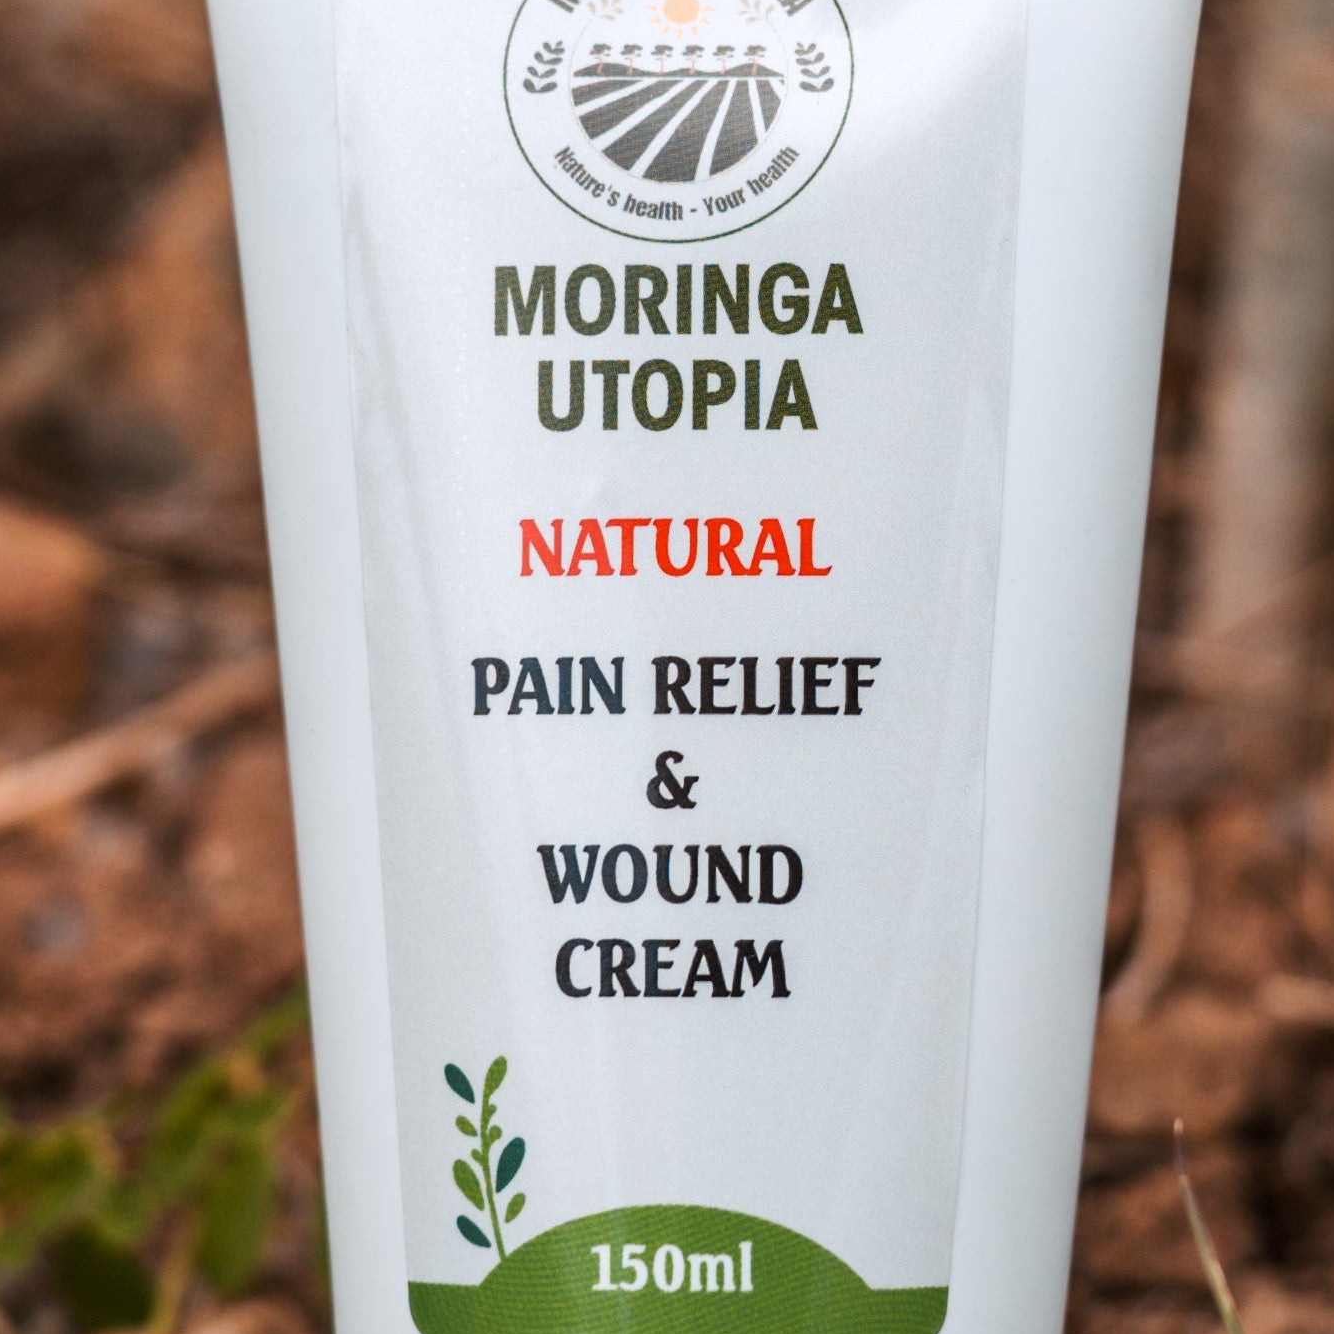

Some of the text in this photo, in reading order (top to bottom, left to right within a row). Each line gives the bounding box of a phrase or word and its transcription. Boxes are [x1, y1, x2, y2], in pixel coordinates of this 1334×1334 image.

[553, 145, 620, 208] Nature's
[623, 193, 684, 221] health
[703, 187, 747, 217] Your
[749, 144, 801, 196] health
[495, 262, 863, 336] MORINGA
[538, 359, 817, 431] UTOPIA
[520, 518, 831, 577] NATURAL
[472, 656, 881, 715] PAIN RELIEF
[647, 751, 699, 809] &
[537, 844, 803, 905] WOUND
[556, 938, 791, 998] CREAM
[591, 1241, 753, 1292] 150ml
